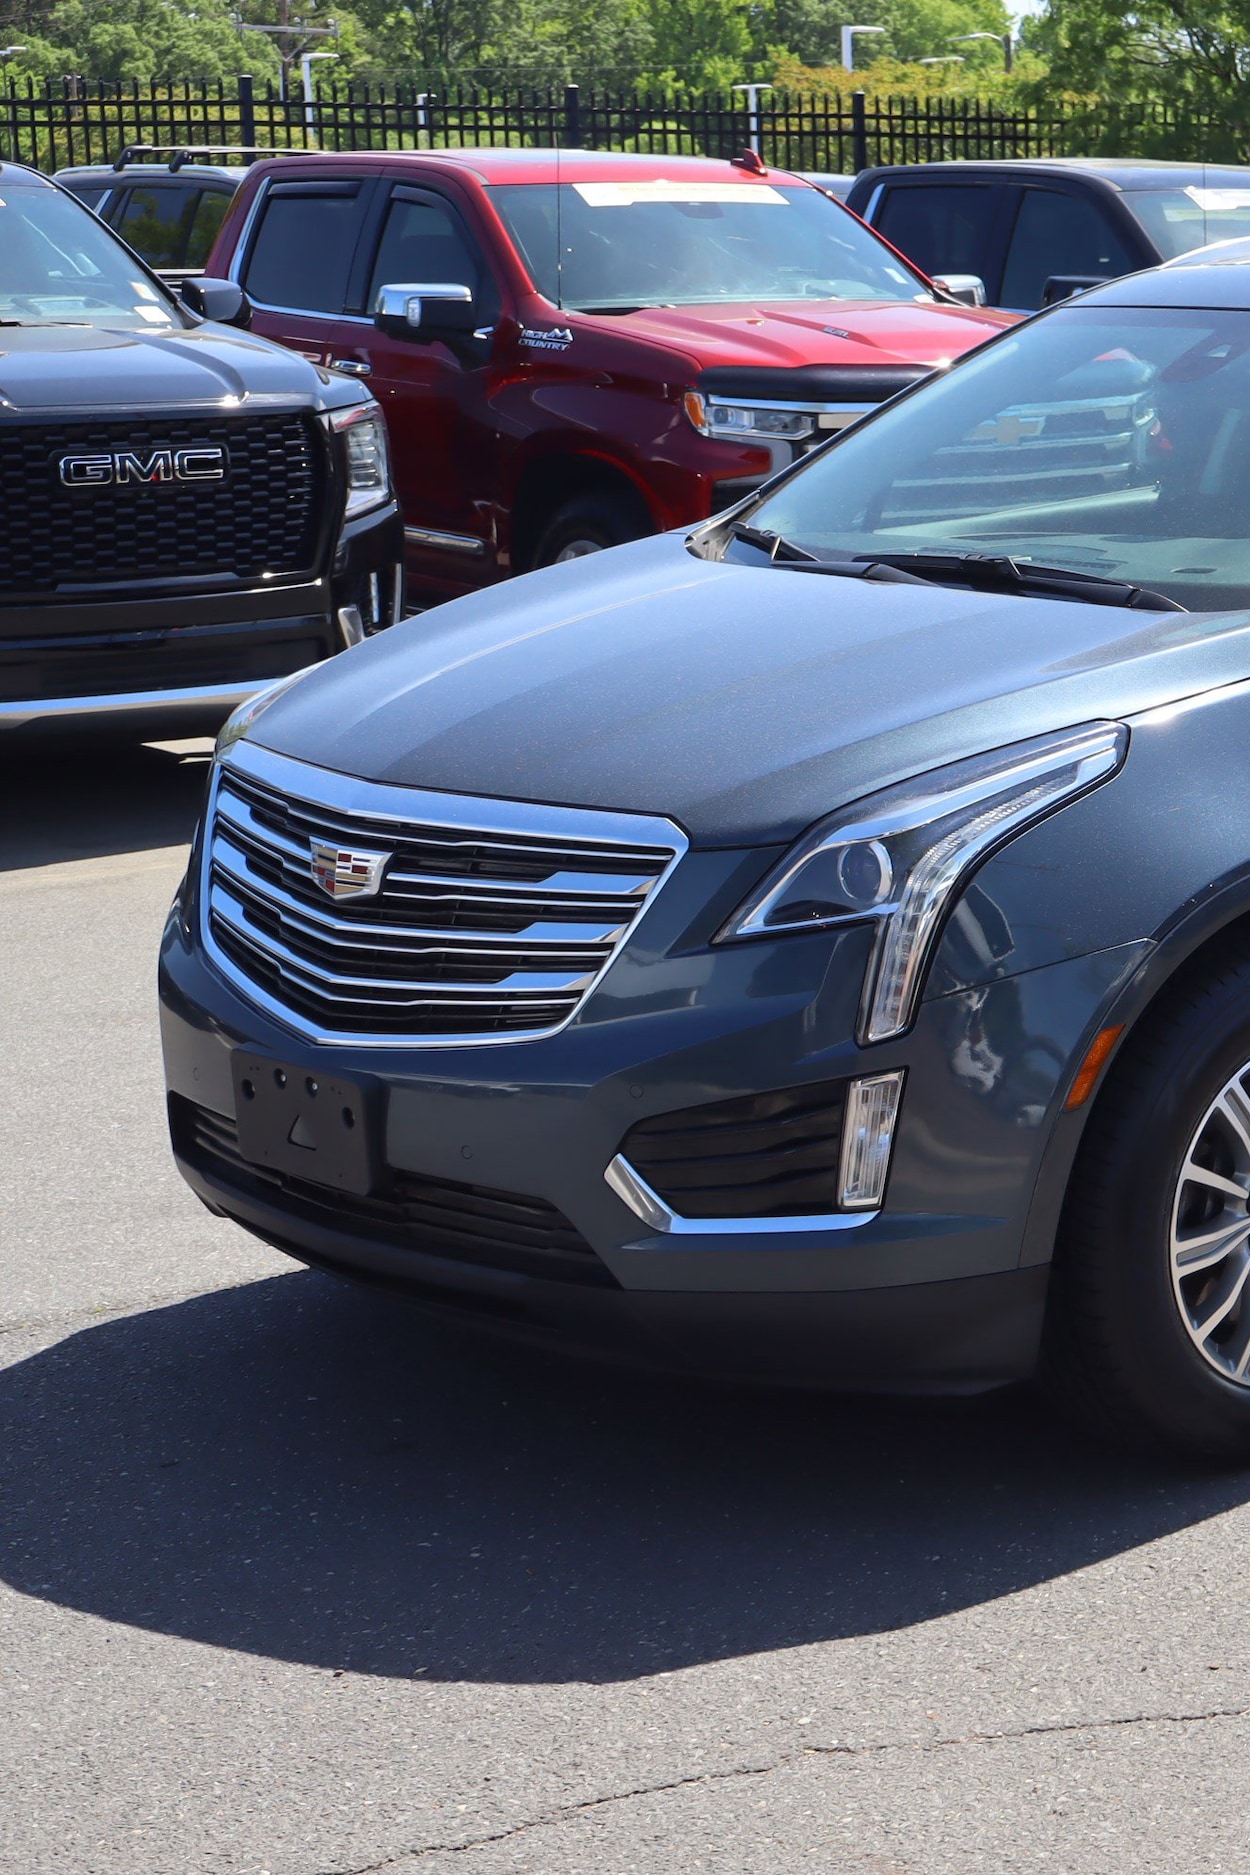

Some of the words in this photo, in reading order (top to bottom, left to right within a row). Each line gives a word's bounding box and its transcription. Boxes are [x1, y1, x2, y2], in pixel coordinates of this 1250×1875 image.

[521, 329, 548, 339] HIGH
[518, 338, 570, 351] COUNTRY
[59, 449, 223, 486] GMC
